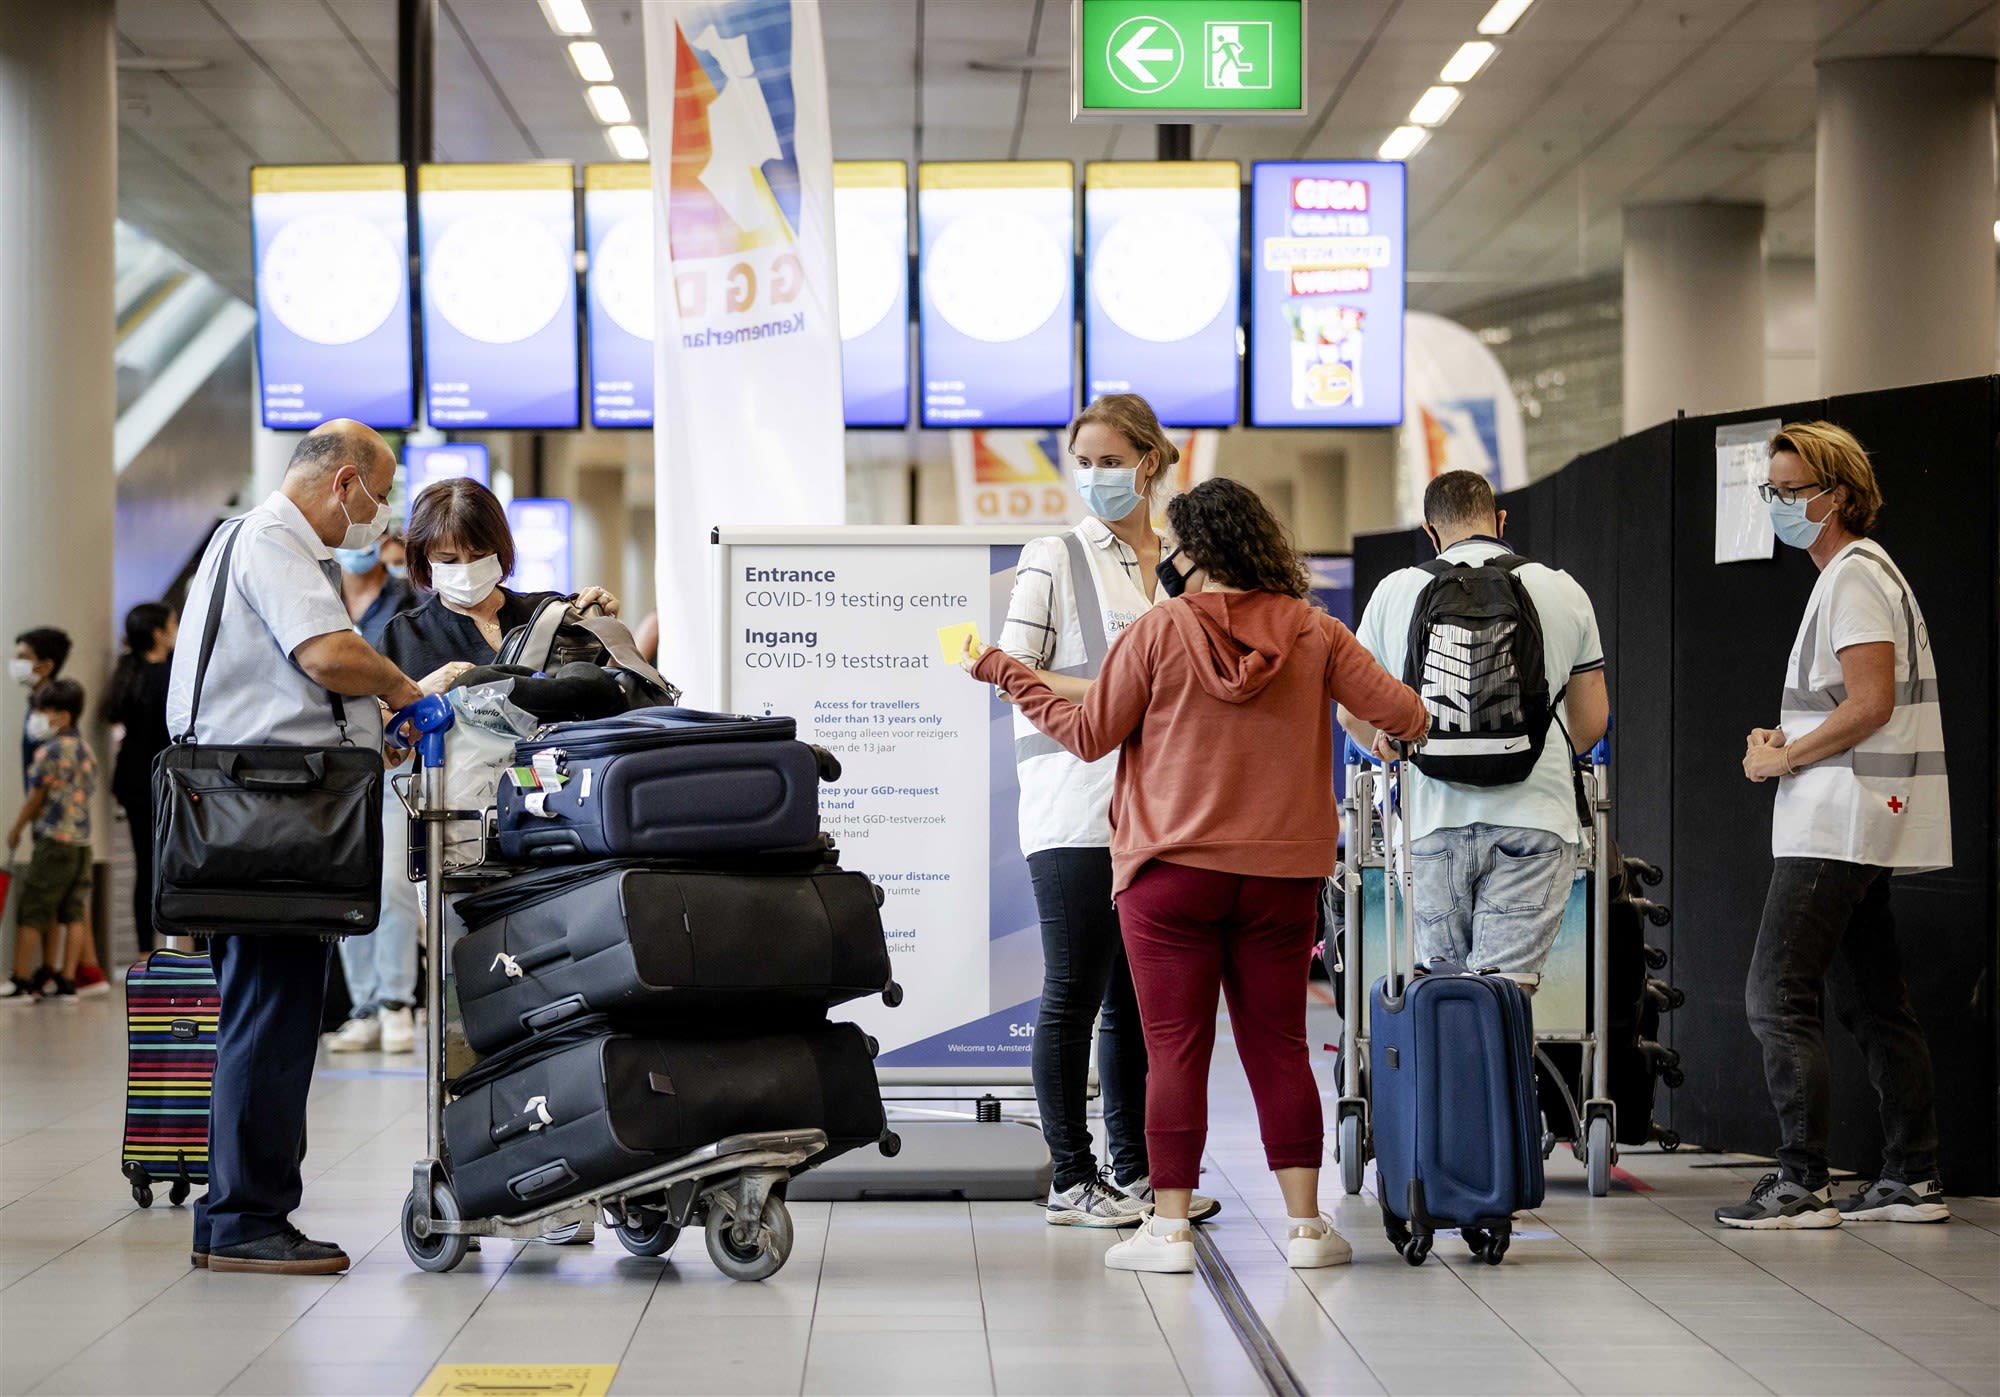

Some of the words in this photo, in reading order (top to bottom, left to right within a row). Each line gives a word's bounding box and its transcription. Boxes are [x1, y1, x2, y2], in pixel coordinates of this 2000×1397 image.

[745, 566, 836, 583] Entrance
[745, 590, 836, 608] COVID-19
[840, 590, 904, 612] testing
[909, 592, 968, 608] centre
[745, 627, 818, 647] Ingang
[745, 652, 836, 669] COVID-19
[841, 652, 929, 669] teststraat
[814, 699, 849, 710] Access
[852, 699, 868, 710] for
[869, 699, 920, 710] travellers
[814, 713, 843, 724] older
[845, 713, 870, 724] than
[873, 714, 886, 724] 13
[888, 715, 917, 727] years
[918, 713, 943, 727] only
[814, 728, 857, 741] Toegang
[859, 728, 890, 738] alleen
[892, 730, 915, 738] voor
[916, 728, 959, 741] reizigers
[848, 742, 861, 753] de
[863, 743, 875, 753] 13
[876, 743, 897, 755] jaar
[844, 787, 869, 798] your
[871, 785, 940, 798] GGD-request
[827, 799, 855, 810] hand
[821, 814, 842, 825] oud
[844, 814, 861, 825] het
[863, 814, 946, 824] GGD-testverzoek
[829, 828, 842, 839] de
[844, 828, 870, 839] hand
[879, 873, 904, 884] your
[906, 871, 951, 881] distance
[887, 887, 921, 896] ruimte
[884, 928, 917, 940] quired
[888, 943, 916, 954] plicht
[947, 1043, 986, 1053] Welcome
[986, 1044, 996, 1053] to
